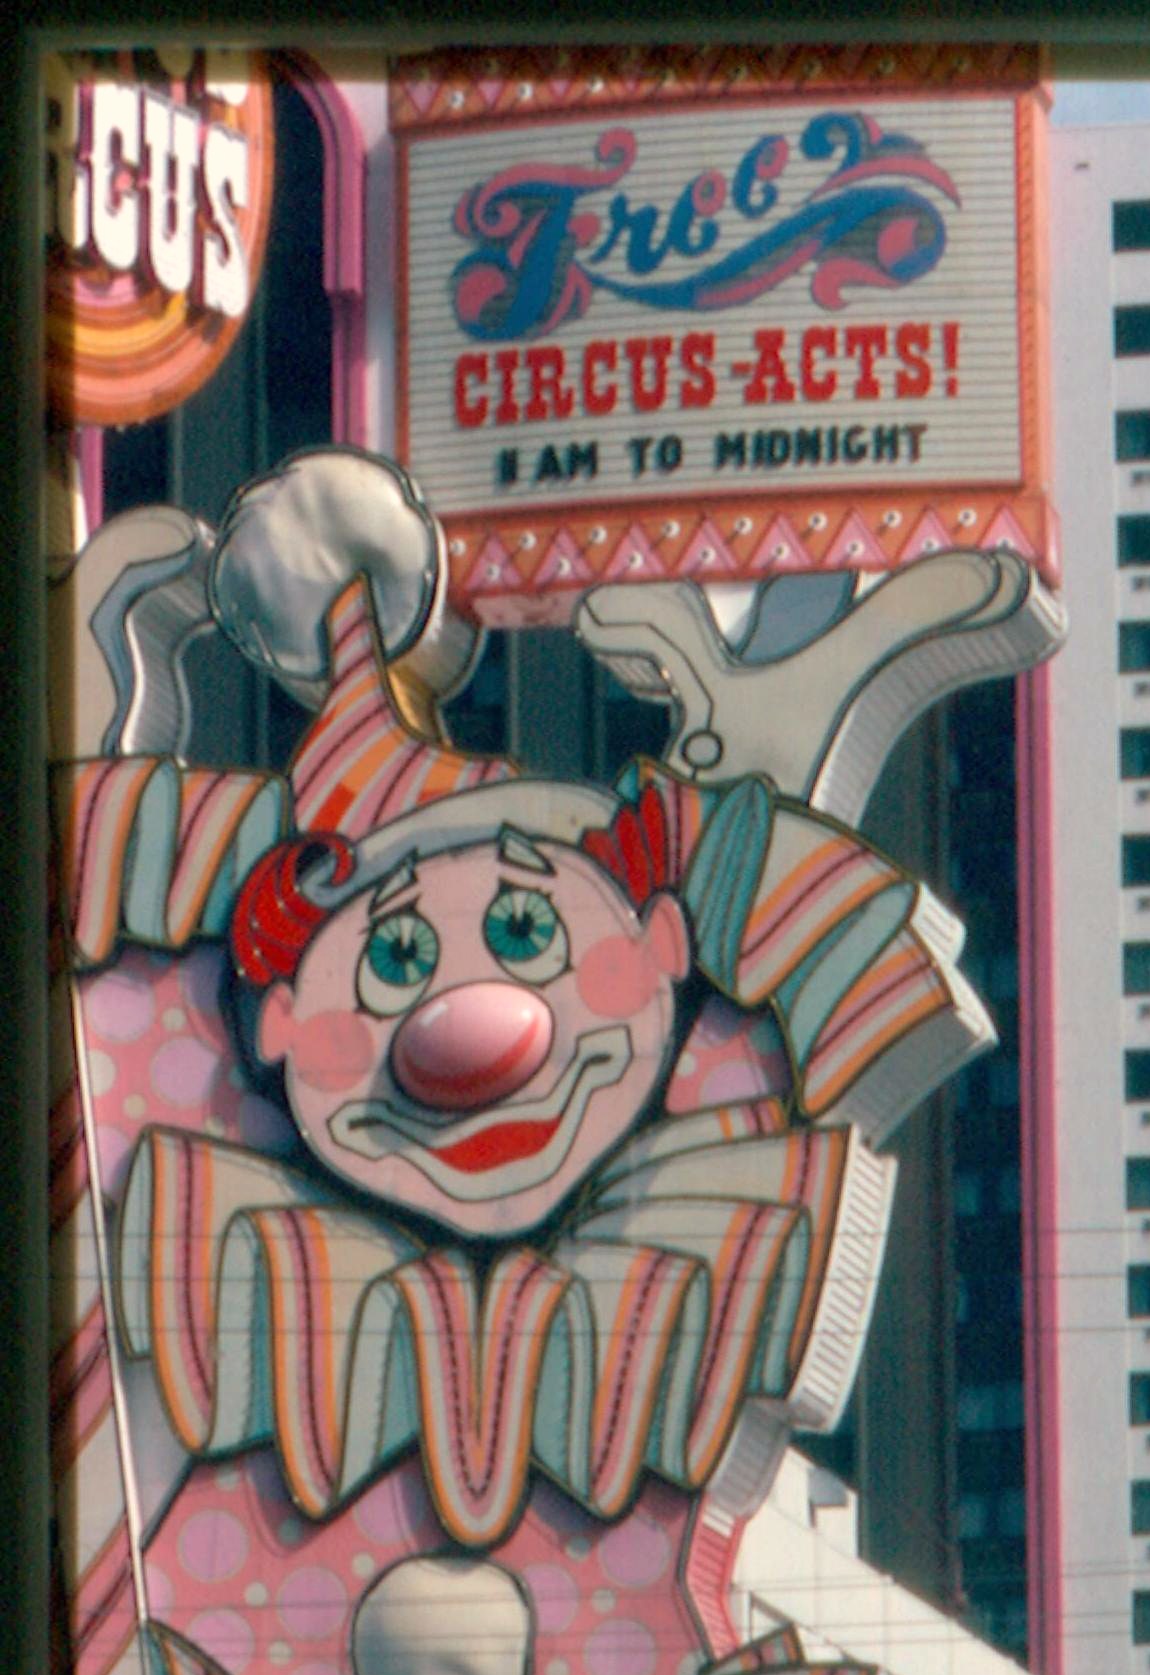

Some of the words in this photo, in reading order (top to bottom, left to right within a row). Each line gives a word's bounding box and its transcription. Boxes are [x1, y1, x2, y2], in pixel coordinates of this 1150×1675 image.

[534, 440, 598, 484] AM
[627, 434, 683, 477] TO
[713, 423, 928, 470] MIDNIGHT
